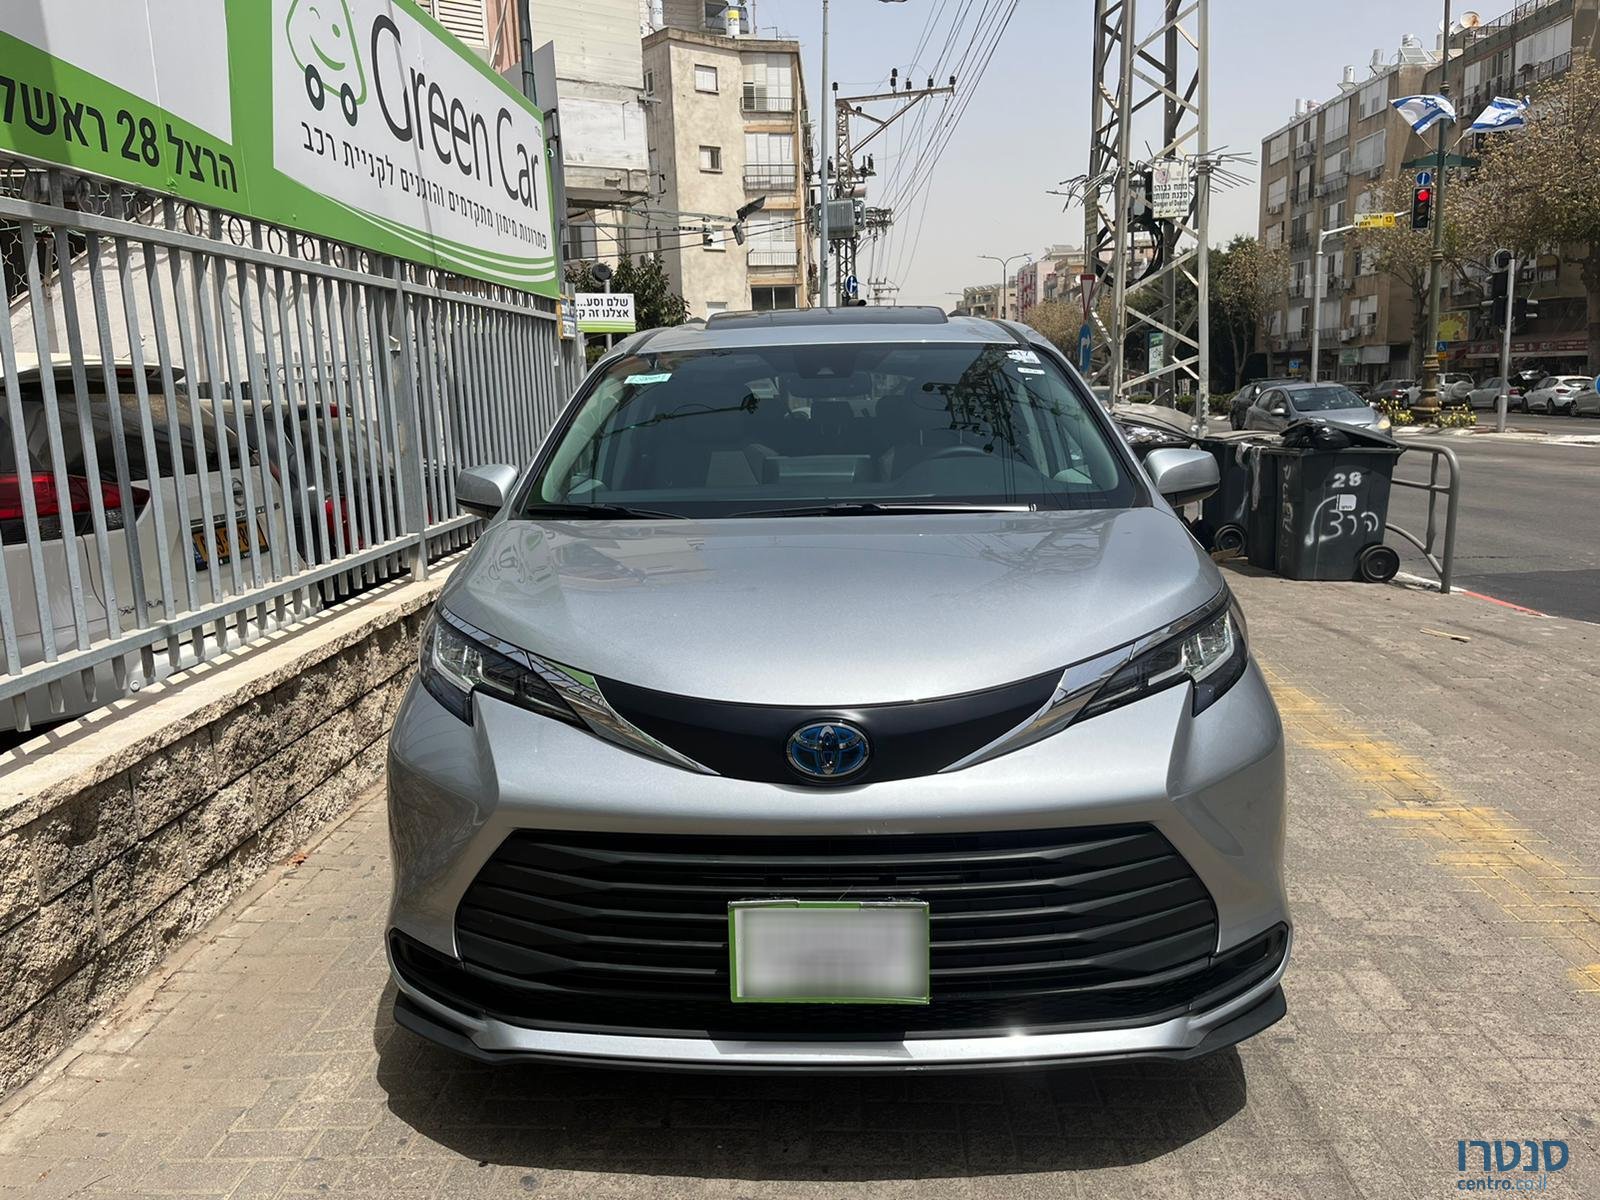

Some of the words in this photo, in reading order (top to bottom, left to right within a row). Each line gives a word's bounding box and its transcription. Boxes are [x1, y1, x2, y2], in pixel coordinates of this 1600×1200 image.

[371, 14, 493, 187] Green
[496, 107, 539, 211] Car
[116, 109, 160, 167] 28
[301, 121, 337, 161] רכב
[165, 124, 238, 193] הרצל
[343, 140, 394, 188] לקניית
[400, 168, 445, 207] והוגנים
[448, 190, 493, 228] מתקדמים
[588, 310, 600, 318] זה
[602, 308, 629, 318] אצלנו
[607, 296, 628, 307] שלם
[1331, 471, 1362, 488] 28
